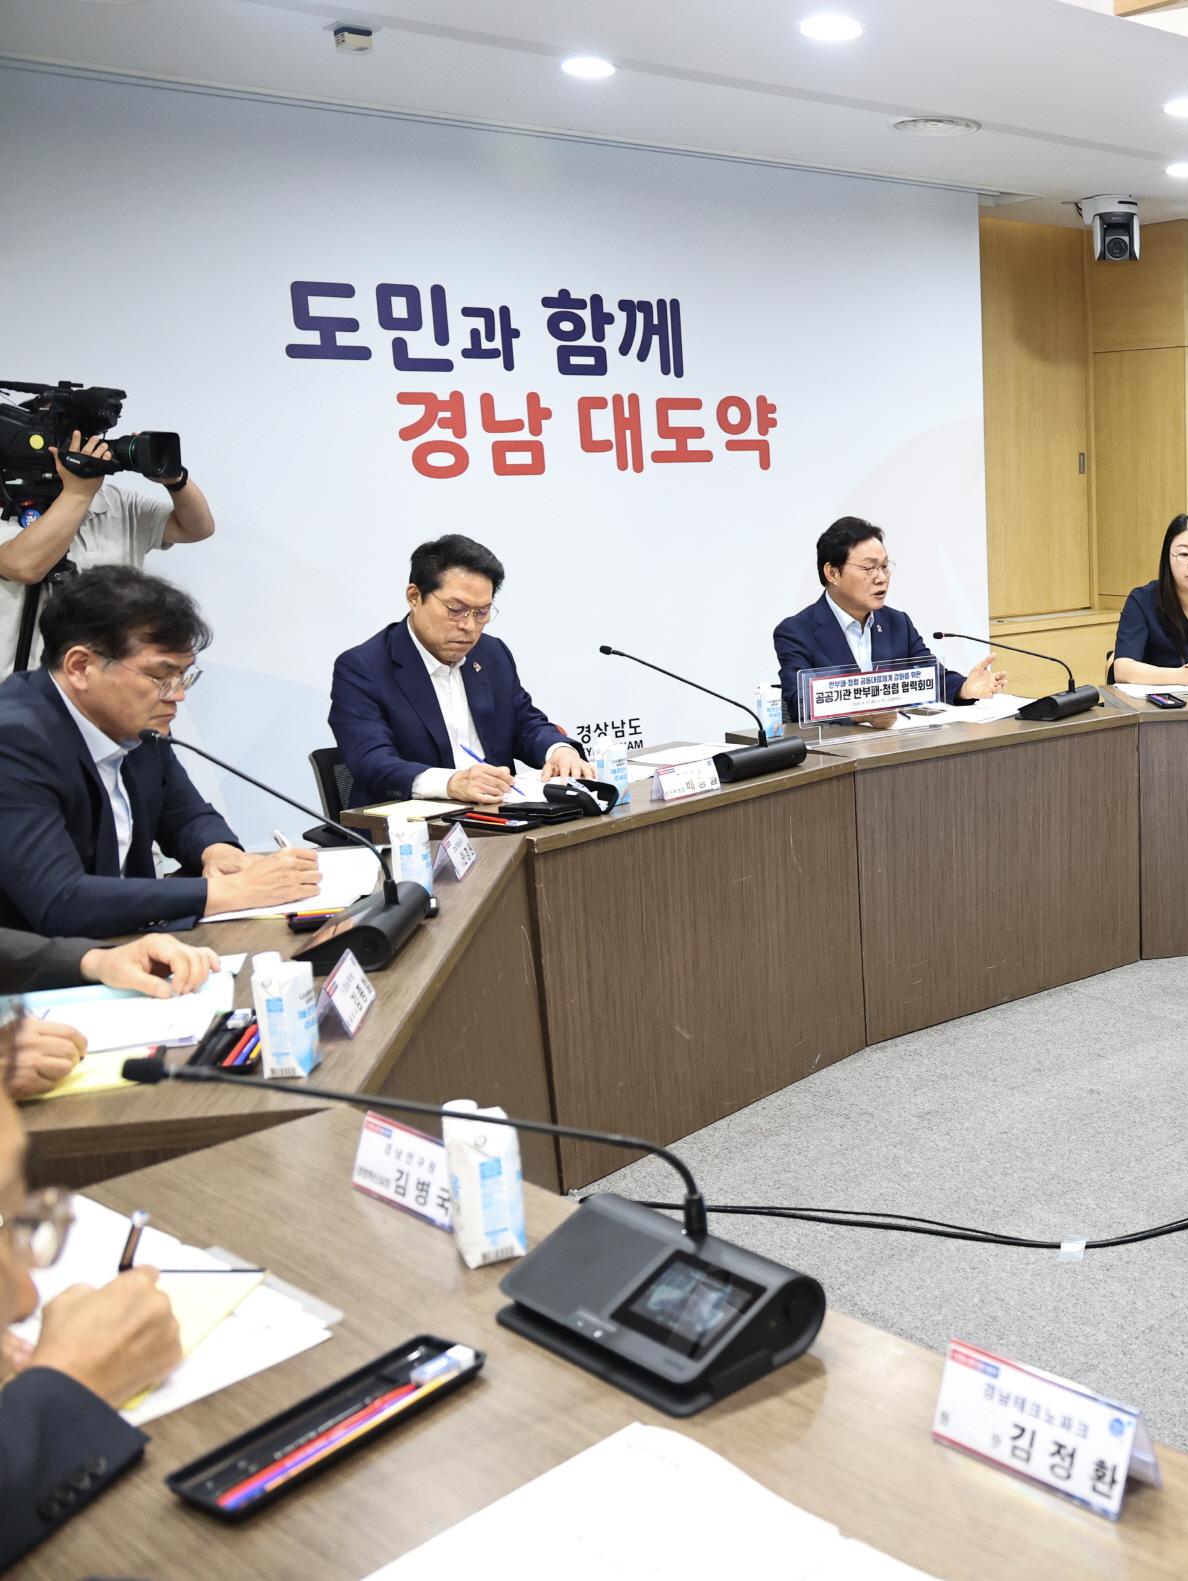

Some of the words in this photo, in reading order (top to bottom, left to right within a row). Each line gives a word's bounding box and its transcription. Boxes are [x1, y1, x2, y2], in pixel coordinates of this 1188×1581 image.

[285, 281, 520, 372] 도민과
[541, 288, 684, 378] 함께
[396, 390, 553, 479] 경남
[577, 393, 778, 473] 대도약
[815, 689, 852, 704] 공공기관
[853, 683, 899, 700] 반부패·청렴
[901, 678, 934, 694] 협력회의
[911, 670, 922, 679] 위한
[576, 718, 643, 744] 경상남도
[983, 1382, 1090, 1440] 경남테크노파크
[1010, 1422, 1118, 1499] 김정환
